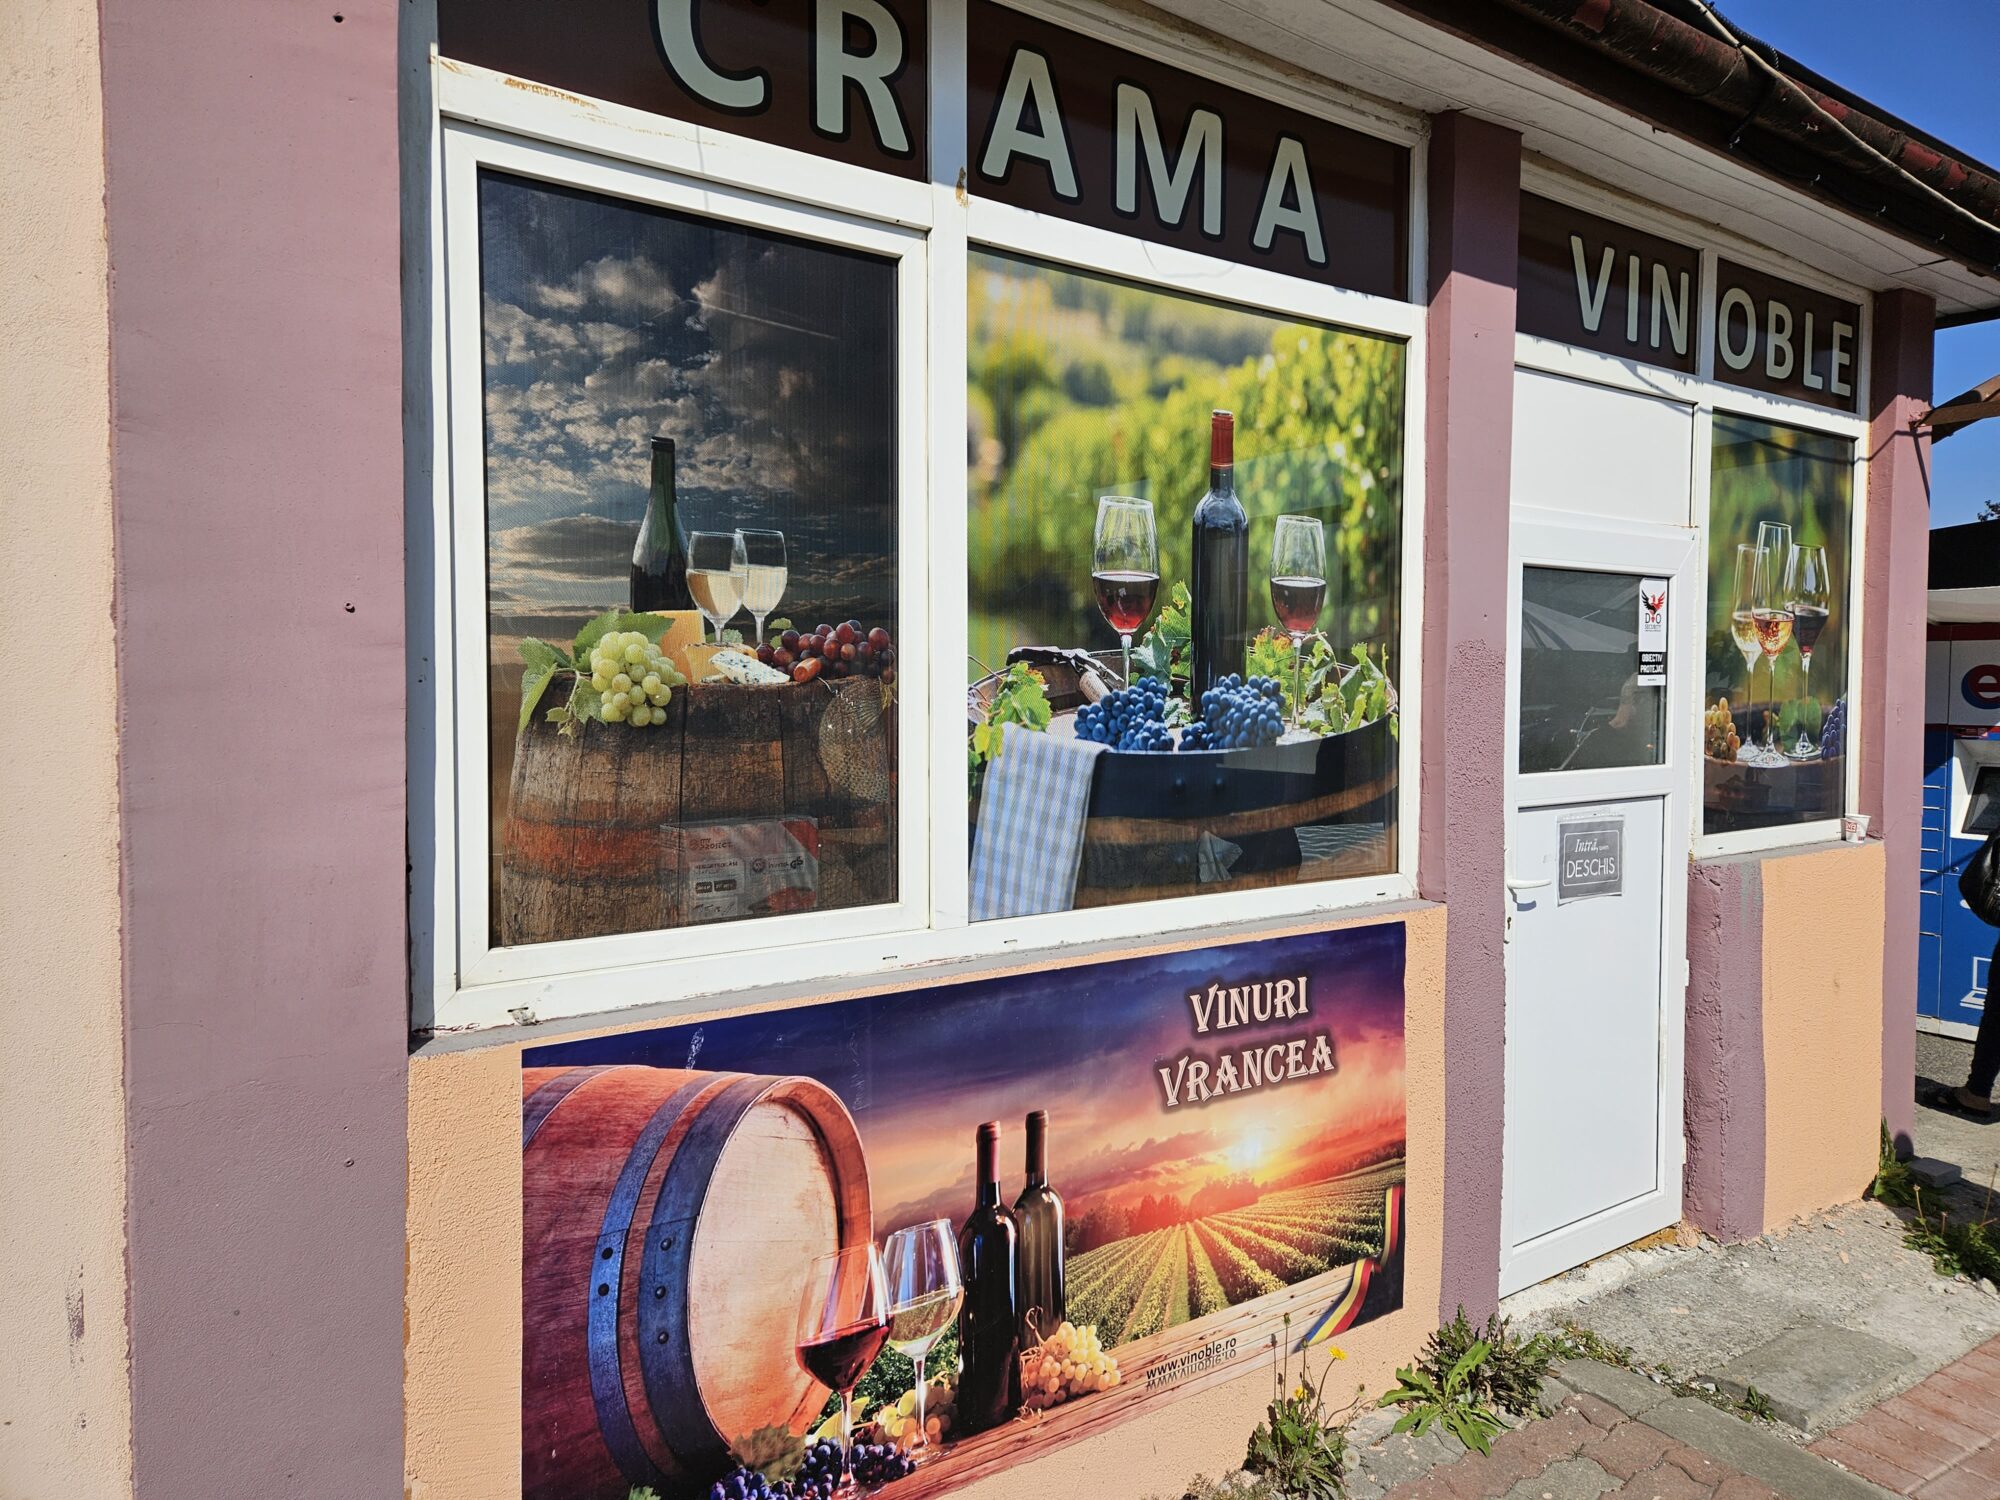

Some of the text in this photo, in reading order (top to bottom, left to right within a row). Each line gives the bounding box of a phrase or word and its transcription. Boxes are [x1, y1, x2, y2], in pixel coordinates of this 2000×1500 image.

[654, 0, 1328, 265] CRAMA
[1640, 664, 1664, 674] PROTEJAT
[1641, 653, 1663, 663] OBIECTIV
[1566, 857, 1616, 879] DESCHIS
[1189, 976, 1309, 1033] VINURI
[1158, 1035, 1336, 1107] VRANCEA
[1146, 1337, 1237, 1380] www.vinoble.ro
